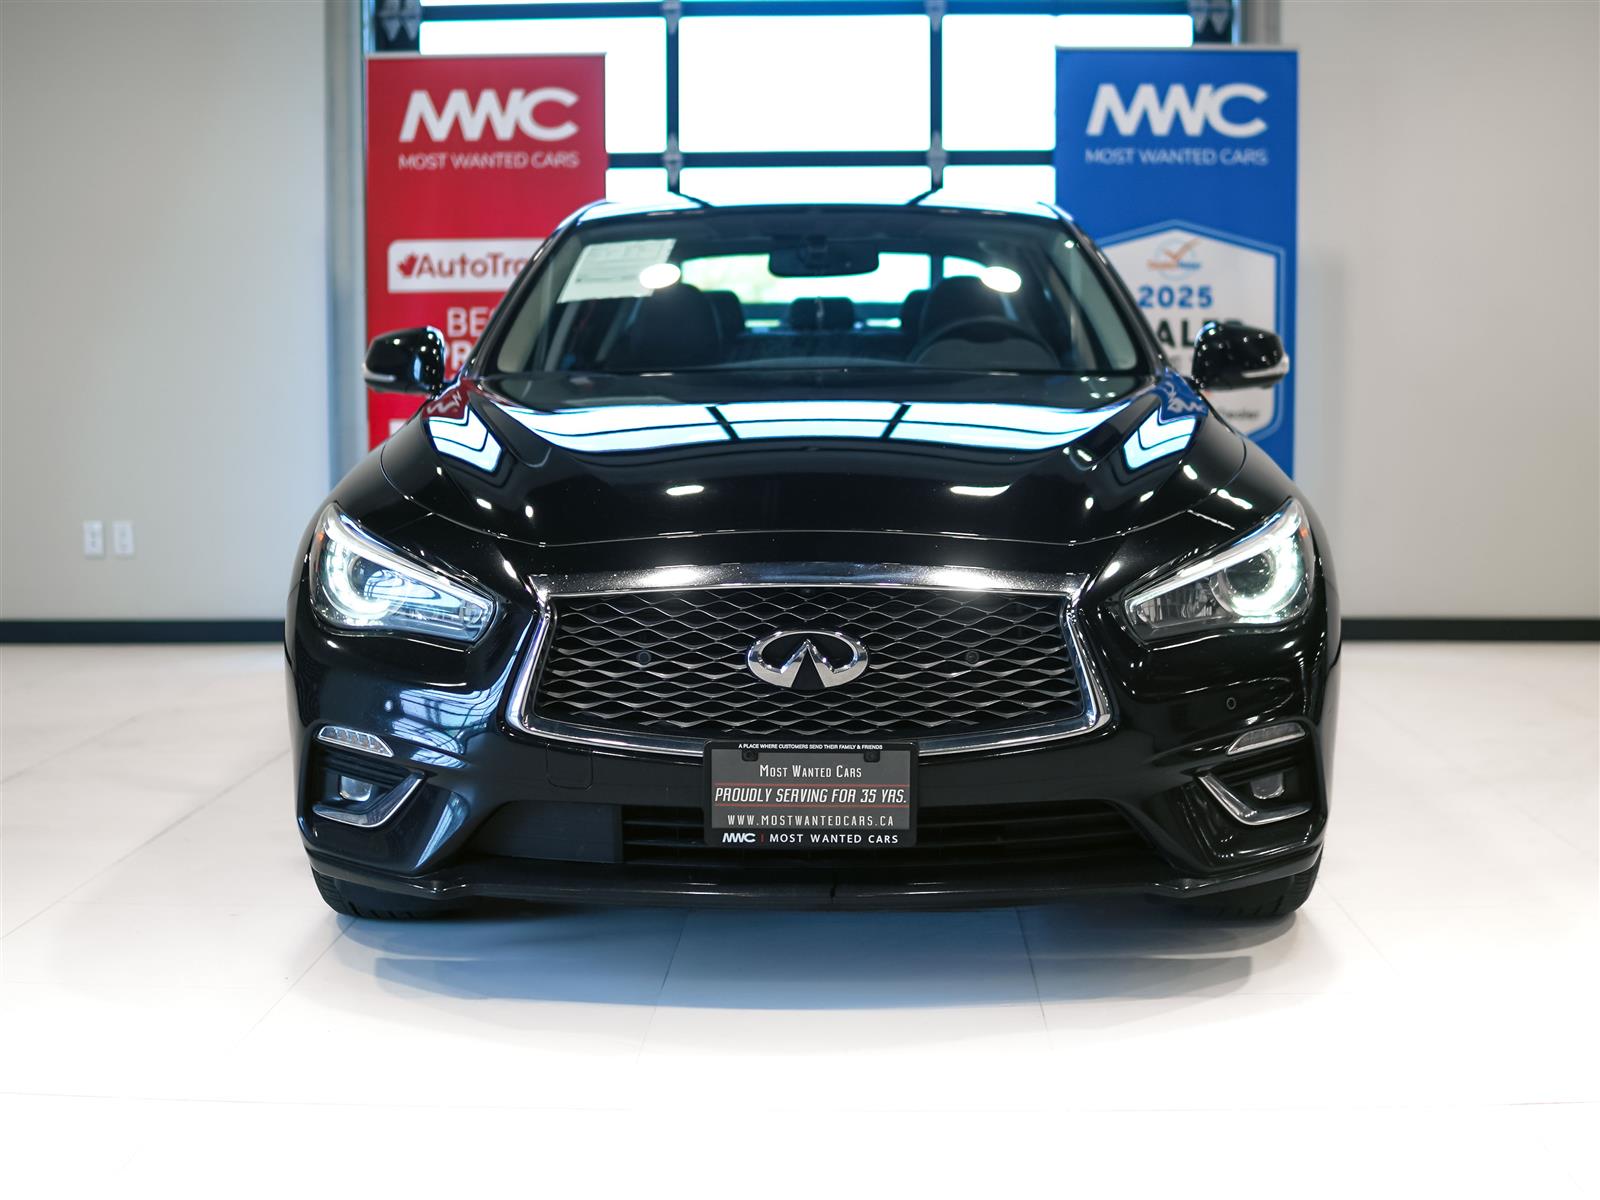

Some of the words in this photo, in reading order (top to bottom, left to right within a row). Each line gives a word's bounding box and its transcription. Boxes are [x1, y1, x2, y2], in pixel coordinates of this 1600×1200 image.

[399, 87, 580, 142] MWC
[1085, 82, 1268, 138] MWC
[399, 152, 447, 170] MOST
[452, 152, 528, 169] WANTED
[531, 151, 579, 168] CARS
[1085, 148, 1135, 165] MOST
[1139, 148, 1217, 165] WANTED
[1219, 147, 1268, 165] CARS
[1139, 285, 1213, 308] 2025
[447, 307, 498, 337] BE
[715, 788, 772, 802] PROUDLY
[776, 788, 828, 802] SERVING
[832, 789, 856, 802] FOR
[861, 789, 876, 803] 35
[881, 789, 907, 803] YRS.
[728, 815, 894, 826] WWW.MOSTWANTEDCARS.CA
[722, 833, 756, 842] MWC
[770, 834, 803, 842] MOST
[811, 834, 862, 843] WANTED
[868, 835, 898, 843] CARS
